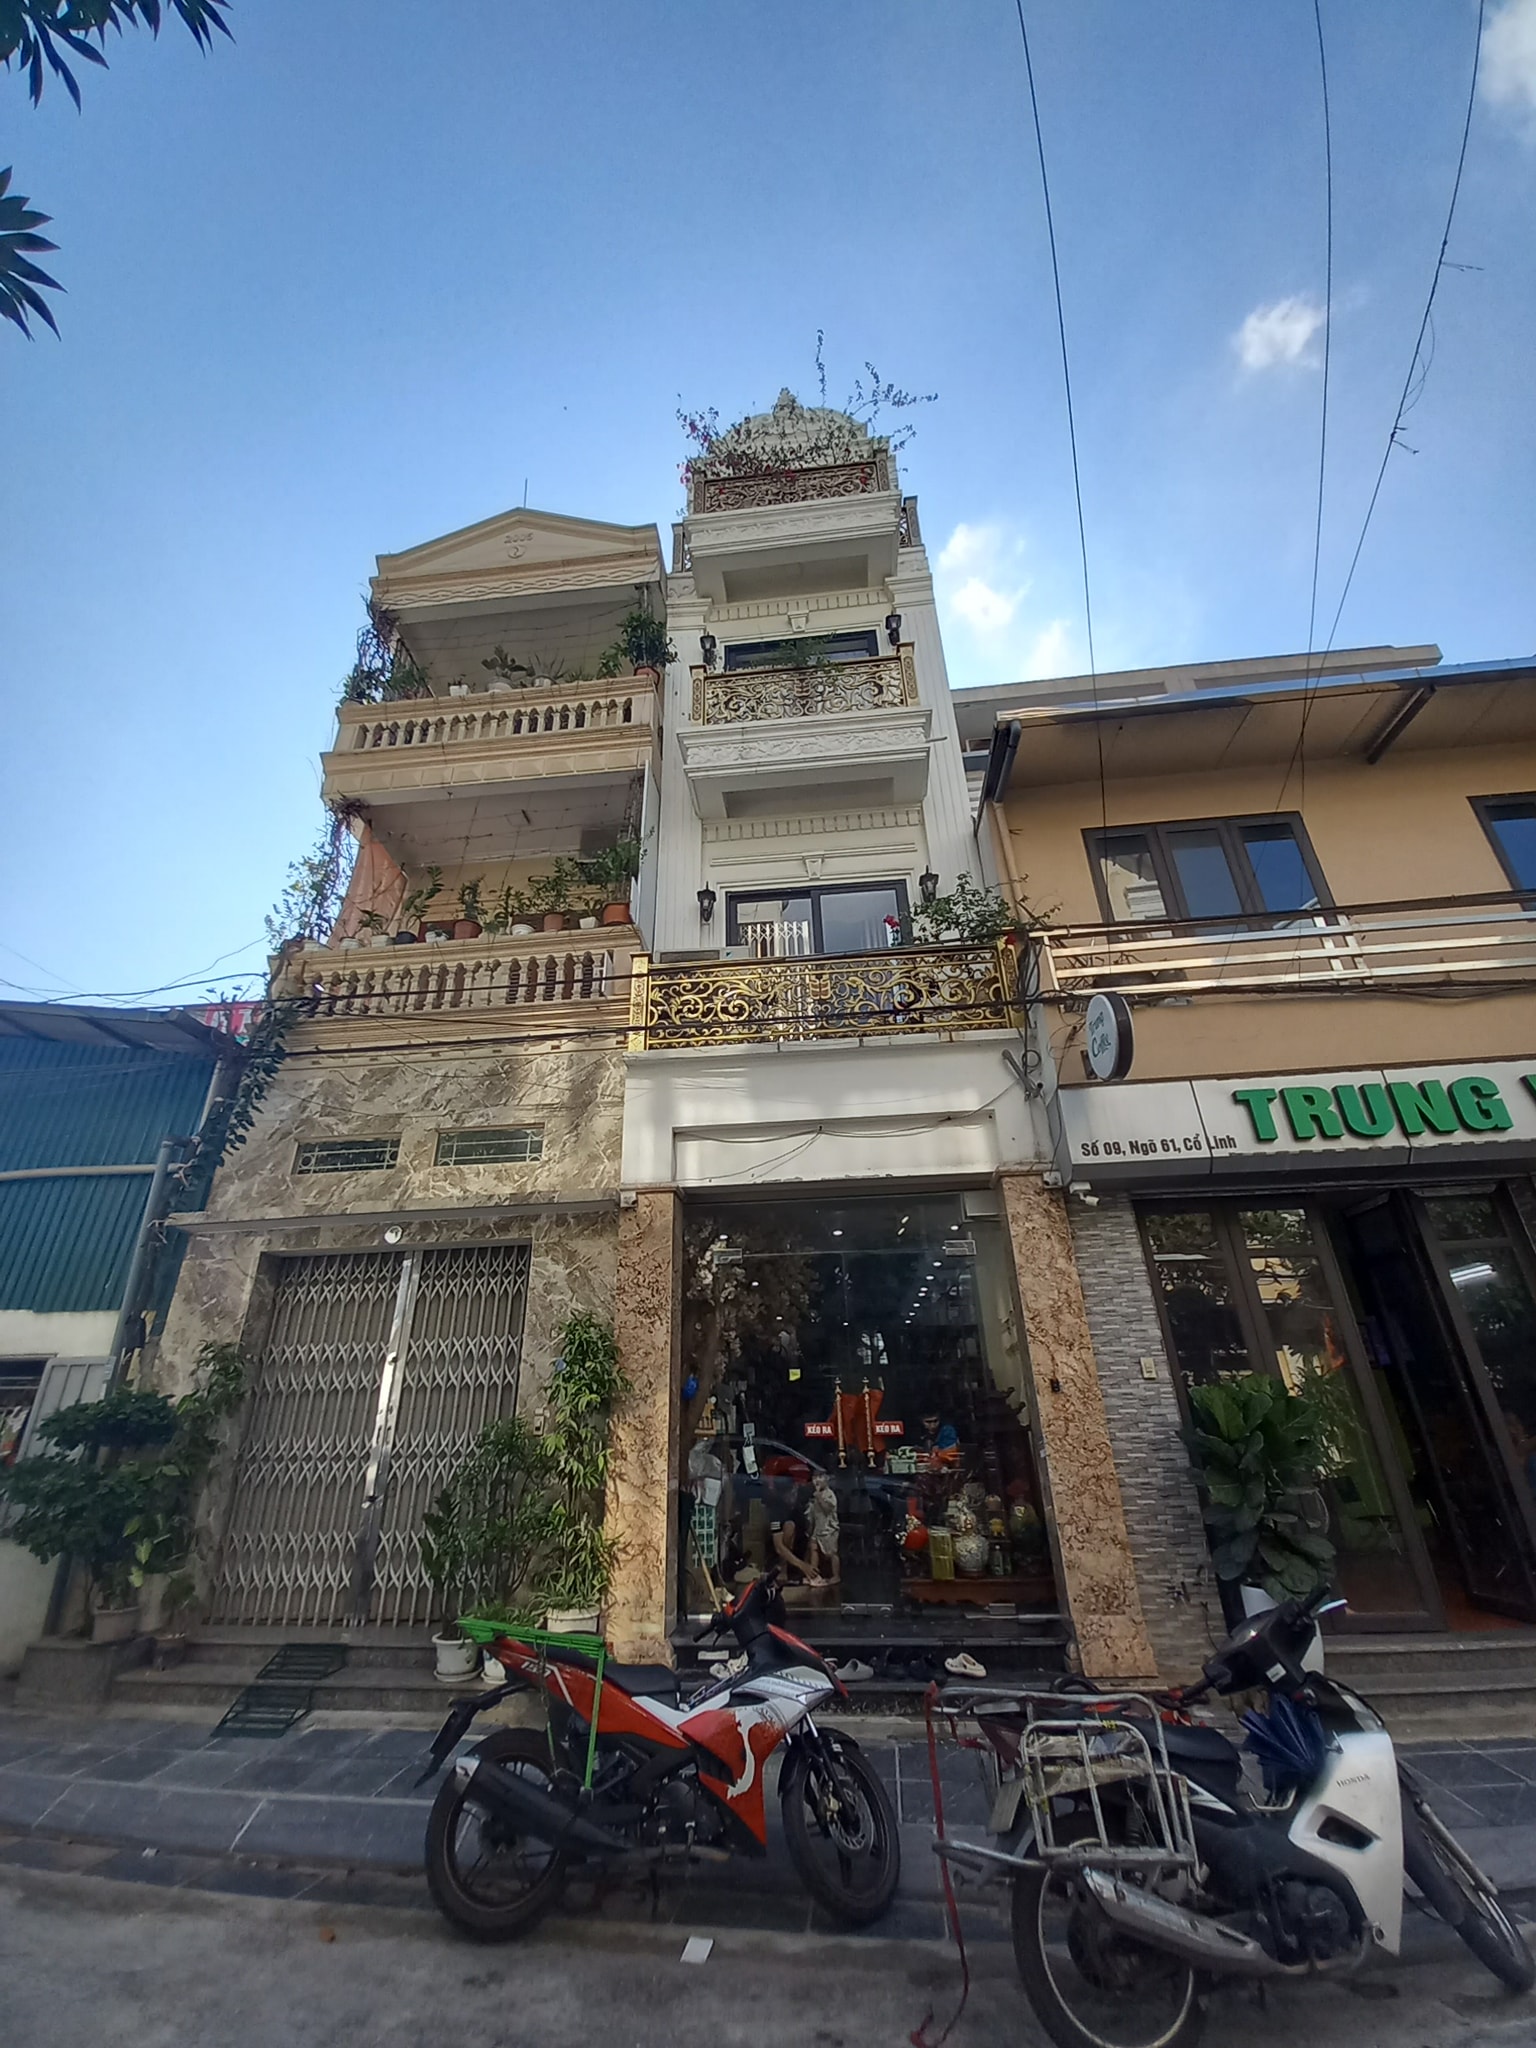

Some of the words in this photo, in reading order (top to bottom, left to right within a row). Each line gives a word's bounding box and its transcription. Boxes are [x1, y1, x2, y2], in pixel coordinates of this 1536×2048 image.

[1232, 1076, 1515, 1142] TRUNG
[1081, 1140, 1100, 1156] Số
[1103, 1141, 1126, 1156] 09,
[1129, 1139, 1157, 1156] Ngõ
[1160, 1138, 1181, 1154] 61,
[1183, 1133, 1203, 1151] Cổ
[807, 1424, 820, 1434] KÉO
[822, 1425, 832, 1434] RA
[875, 1423, 889, 1433] KÉO
[891, 1424, 900, 1433] RA
[1336, 1774, 1370, 1787] HONDA
